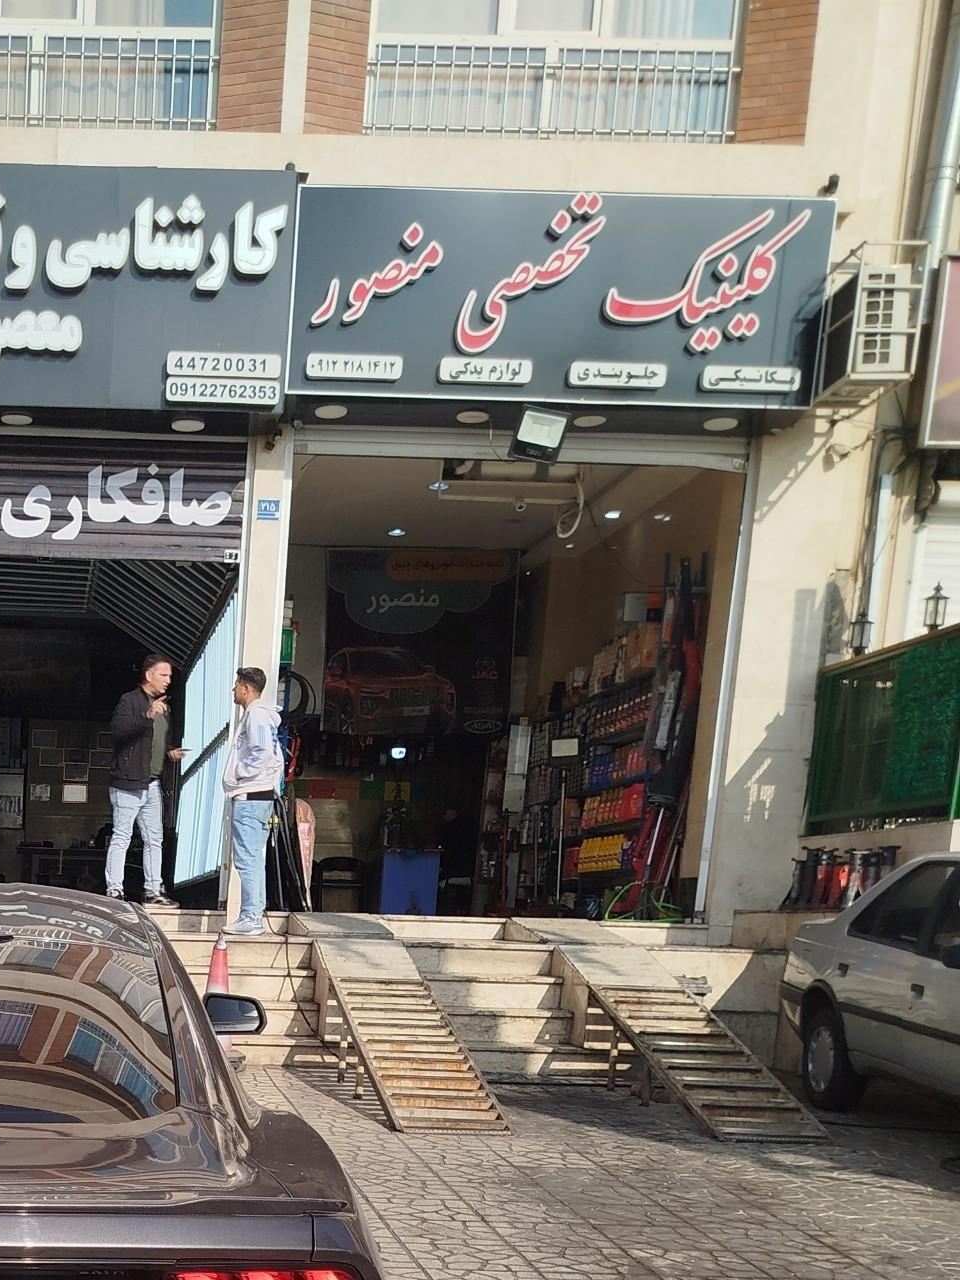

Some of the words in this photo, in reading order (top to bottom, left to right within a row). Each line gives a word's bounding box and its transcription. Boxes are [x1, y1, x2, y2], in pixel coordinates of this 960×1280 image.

[45, 193, 288, 293] کارشناسی
[5, 224, 36, 290] و
[309, 222, 444, 328] منصور
[454, 192, 606, 356] تخصصی
[603, 208, 812, 354] کلینیک
[174, 356, 267, 373] 44720031
[311, 357, 337, 372] ۰۹۱۲
[449, 361, 483, 380] یدکی
[489, 361, 522, 381] لوازم
[577, 365, 659, 384] جلوبندی
[708, 368, 796, 386] مکانیکی
[169, 382, 277, 400] 09122762353
[1, 463, 233, 540] صافکاری
[260, 501, 277, 512] ۲۱۵
[366, 588, 440, 614] منصور
